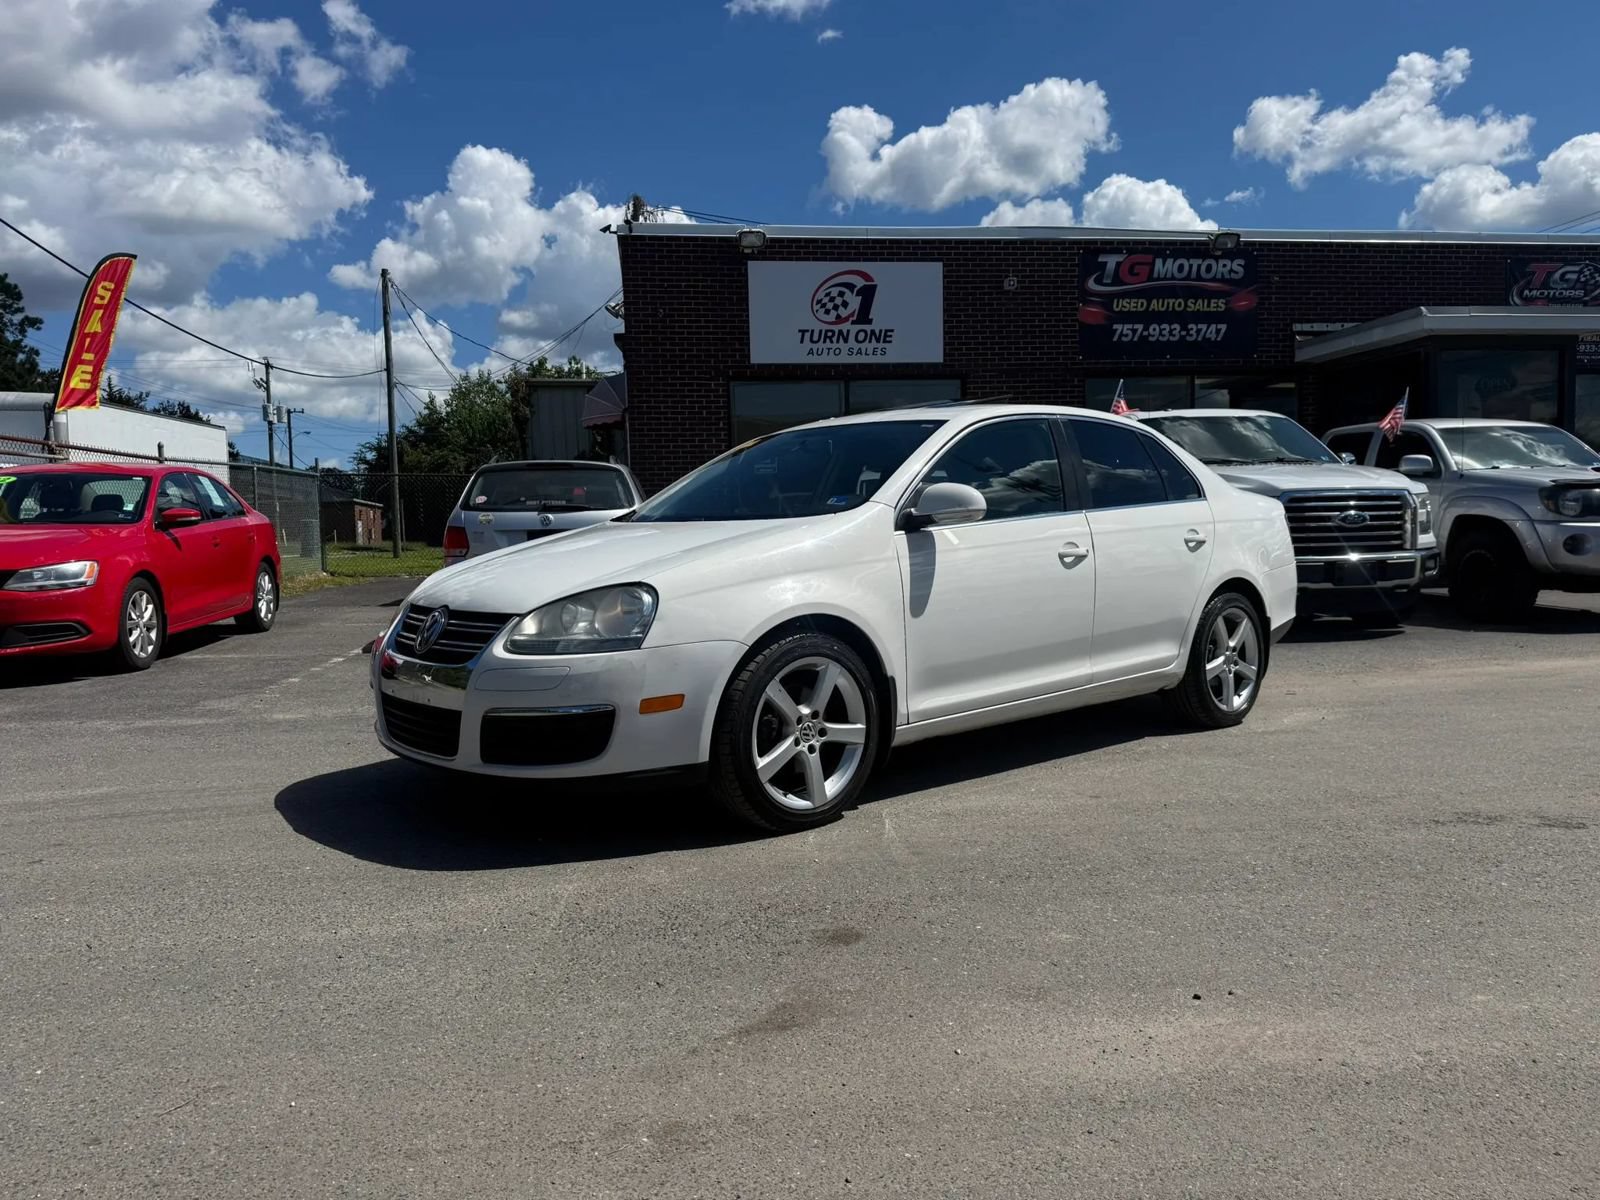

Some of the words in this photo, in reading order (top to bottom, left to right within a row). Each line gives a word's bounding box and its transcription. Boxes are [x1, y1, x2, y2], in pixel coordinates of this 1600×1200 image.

[1098, 254, 1154, 284] TG
[1153, 258, 1245, 280] MOTORS
[1526, 263, 1583, 289] TG
[1522, 289, 1585, 298] MOTORS
[1113, 298, 1147, 312] USED
[1149, 299, 1184, 312] AUTO
[1186, 299, 1226, 312] SALES
[69, 281, 115, 390] SALE
[798, 329, 851, 344] TURN
[854, 329, 895, 344] ONE
[1112, 323, 1227, 342] 757-933-3747
[806, 347, 842, 357] AUTO
[847, 347, 887, 357] SALES
